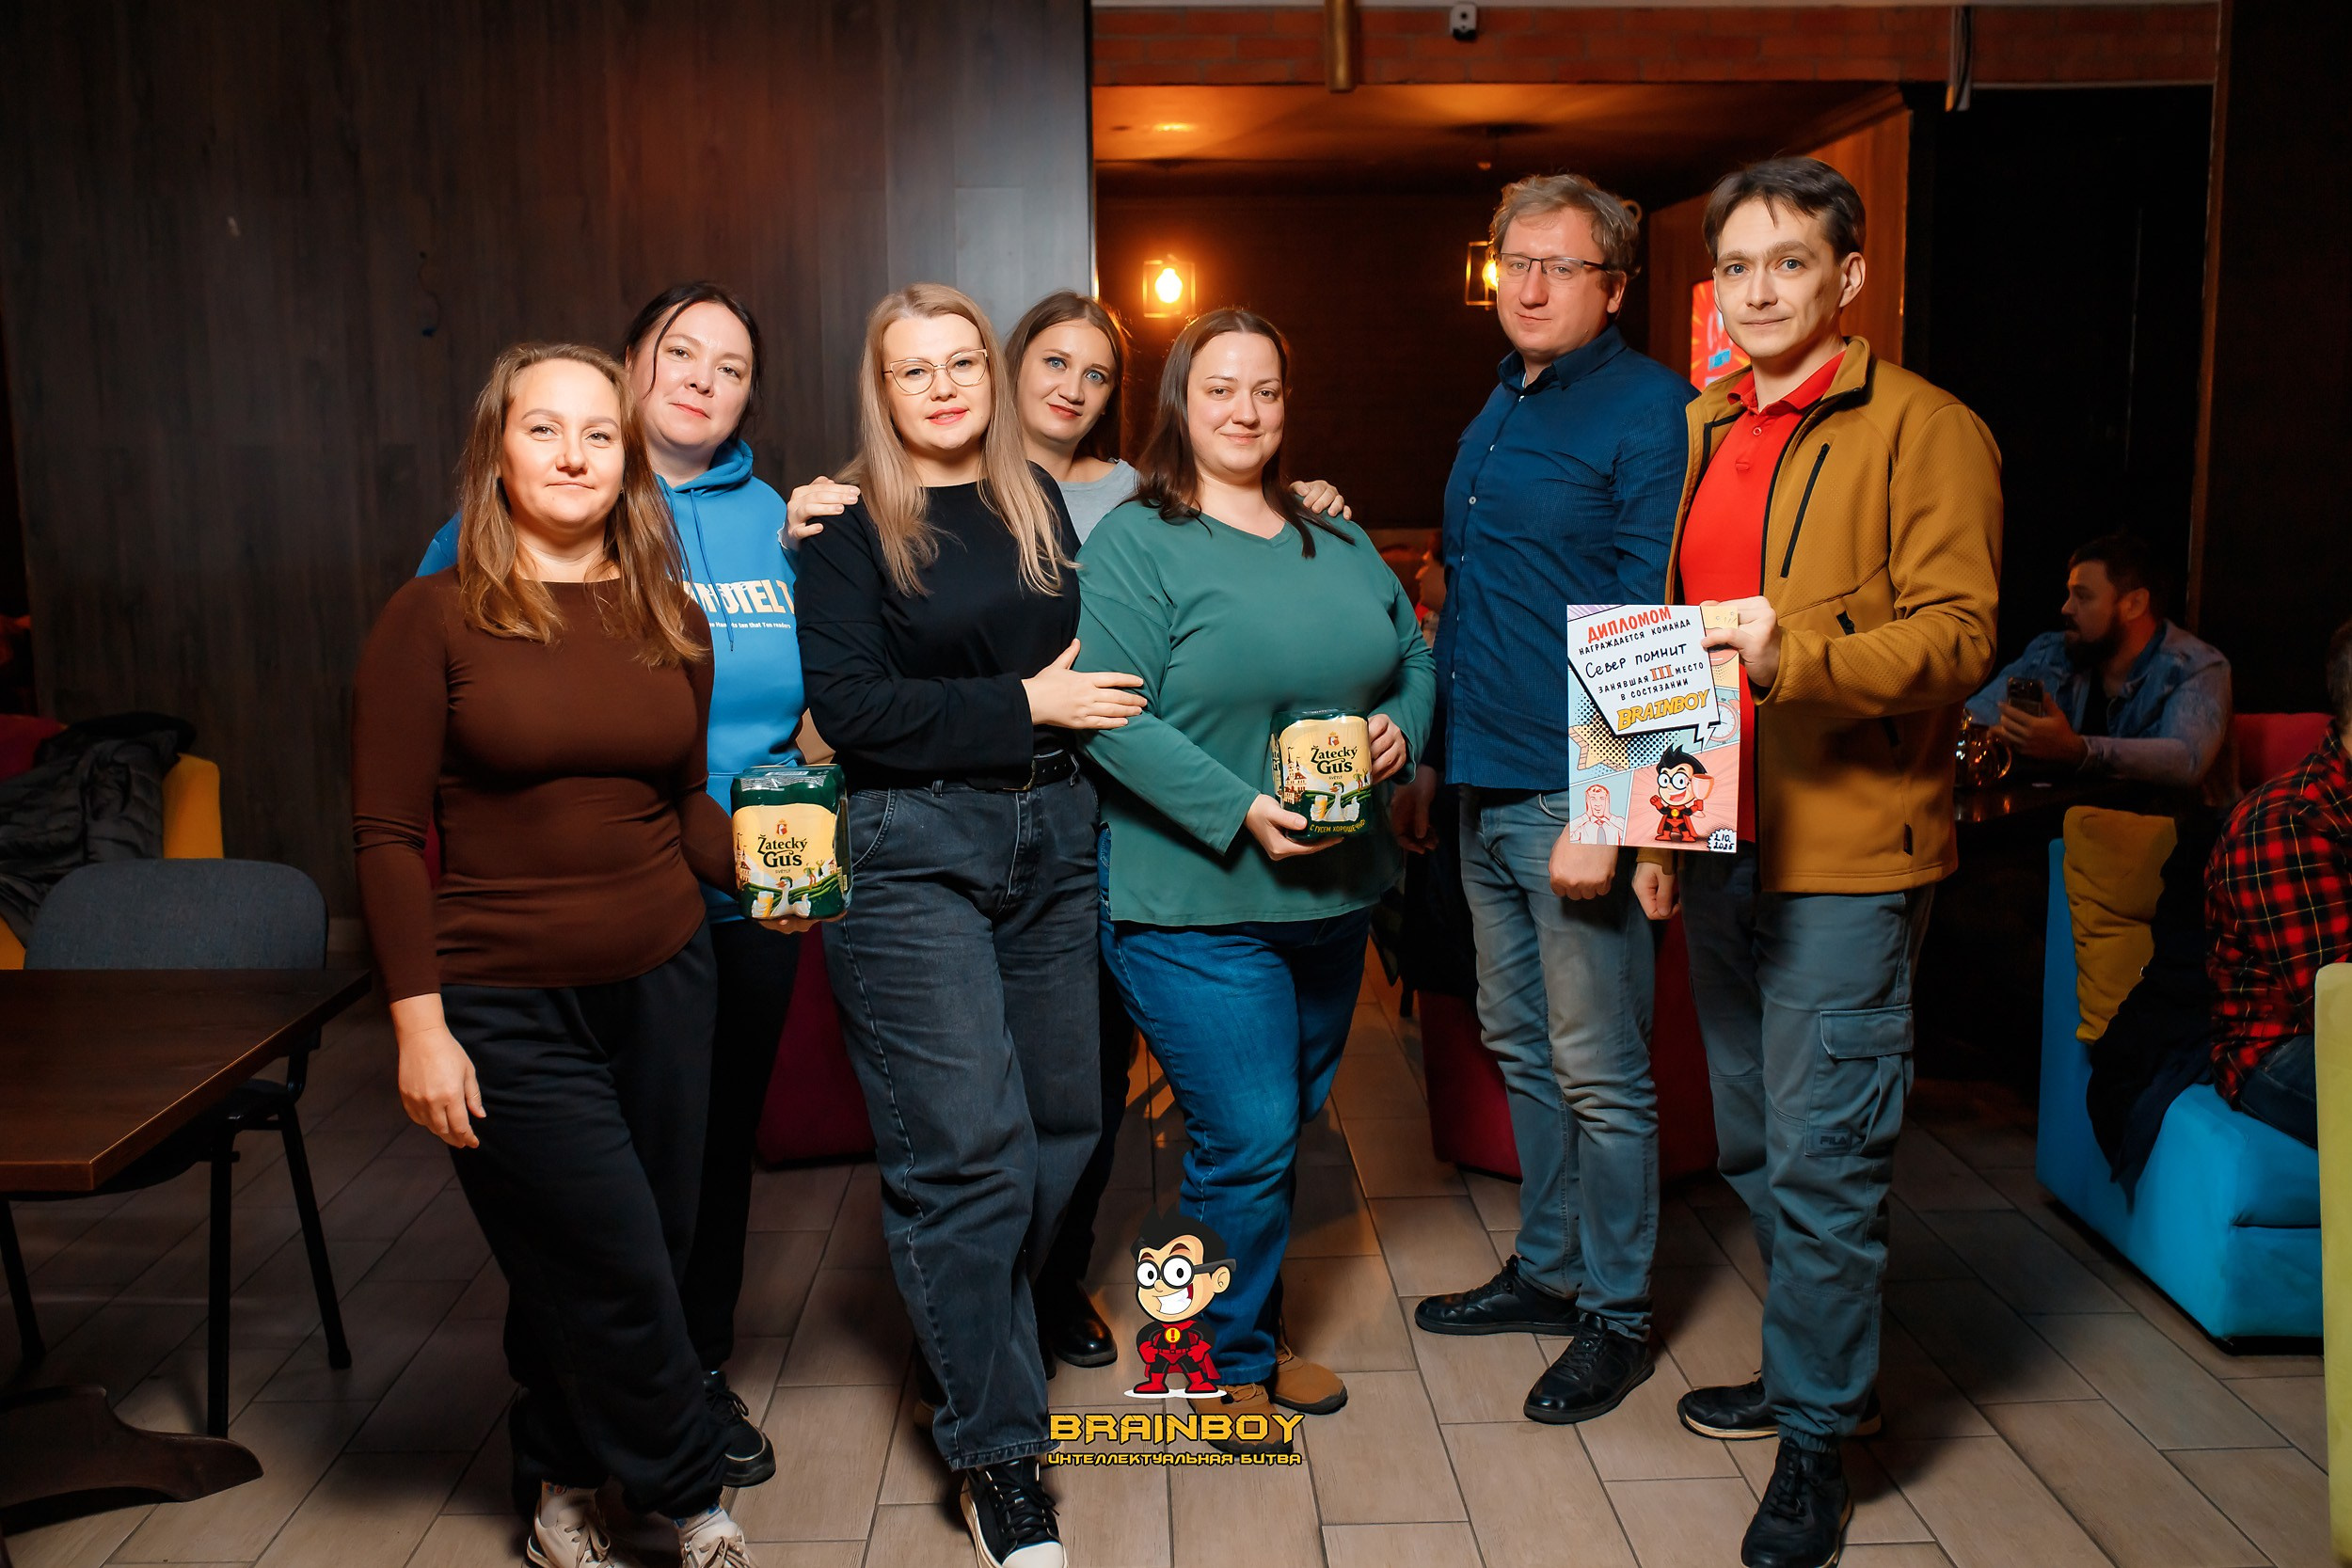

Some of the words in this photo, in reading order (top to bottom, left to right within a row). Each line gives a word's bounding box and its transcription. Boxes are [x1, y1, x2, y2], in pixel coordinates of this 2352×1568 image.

[1588, 607, 1672, 644] ДИПЛОМОМ
[1579, 631, 1645, 656] НАГРАЖДАЕТСЯ
[1651, 619, 1692, 636] КОМАНДА
[1585, 657, 1627, 679] Север
[1598, 675, 1649, 694] ЗАНЯВШАЯ
[1675, 661, 1704, 675] МЕСТО
[1630, 678, 1689, 698] СОСТЯЗАНИИ
[1616, 689, 1710, 732] BRAINBOY
[1311, 745, 1358, 764] Žatecký
[1317, 758, 1353, 775] Gus
[756, 833, 808, 855] Žatecký
[763, 849, 803, 868] Gus
[1820, 1135, 1847, 1146] FILA
